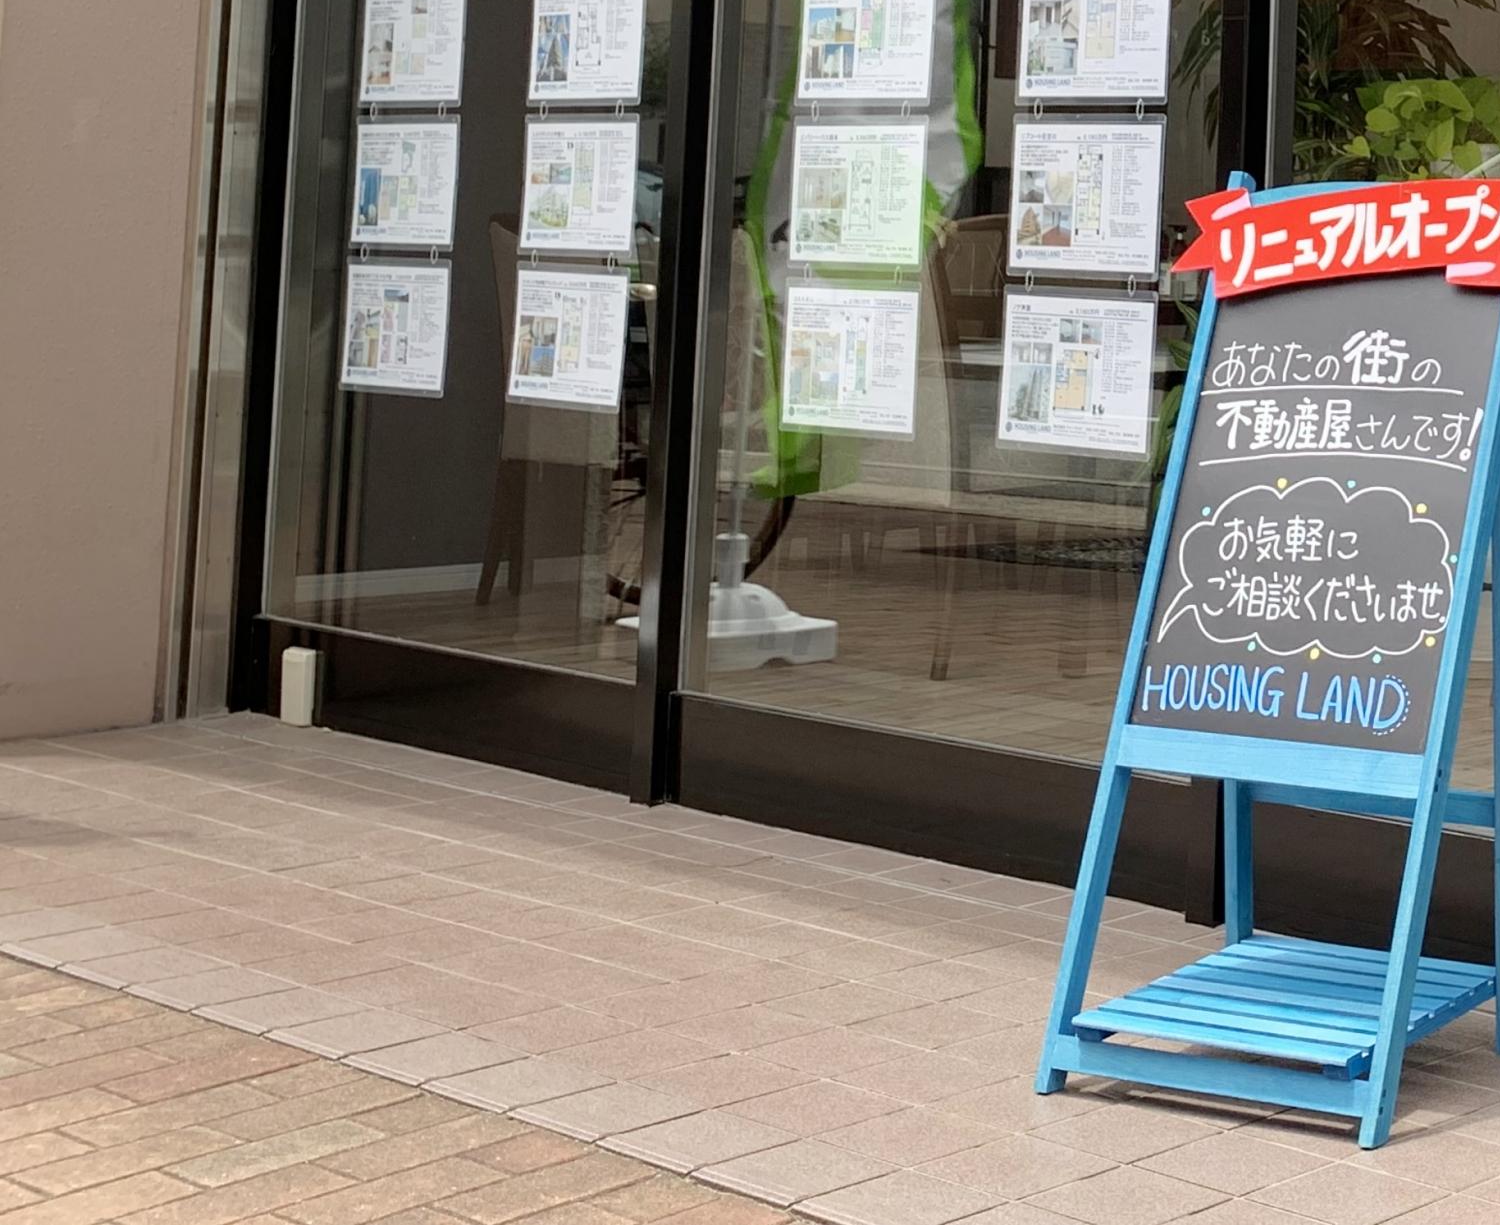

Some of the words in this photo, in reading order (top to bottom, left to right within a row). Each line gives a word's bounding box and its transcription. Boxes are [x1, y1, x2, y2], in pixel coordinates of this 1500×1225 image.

[1211, 329, 1442, 388] あなたの街の
[1218, 513, 1359, 563] お気軽に
[1140, 662, 1286, 719] HOUSING
[1295, 670, 1407, 731] LAND
